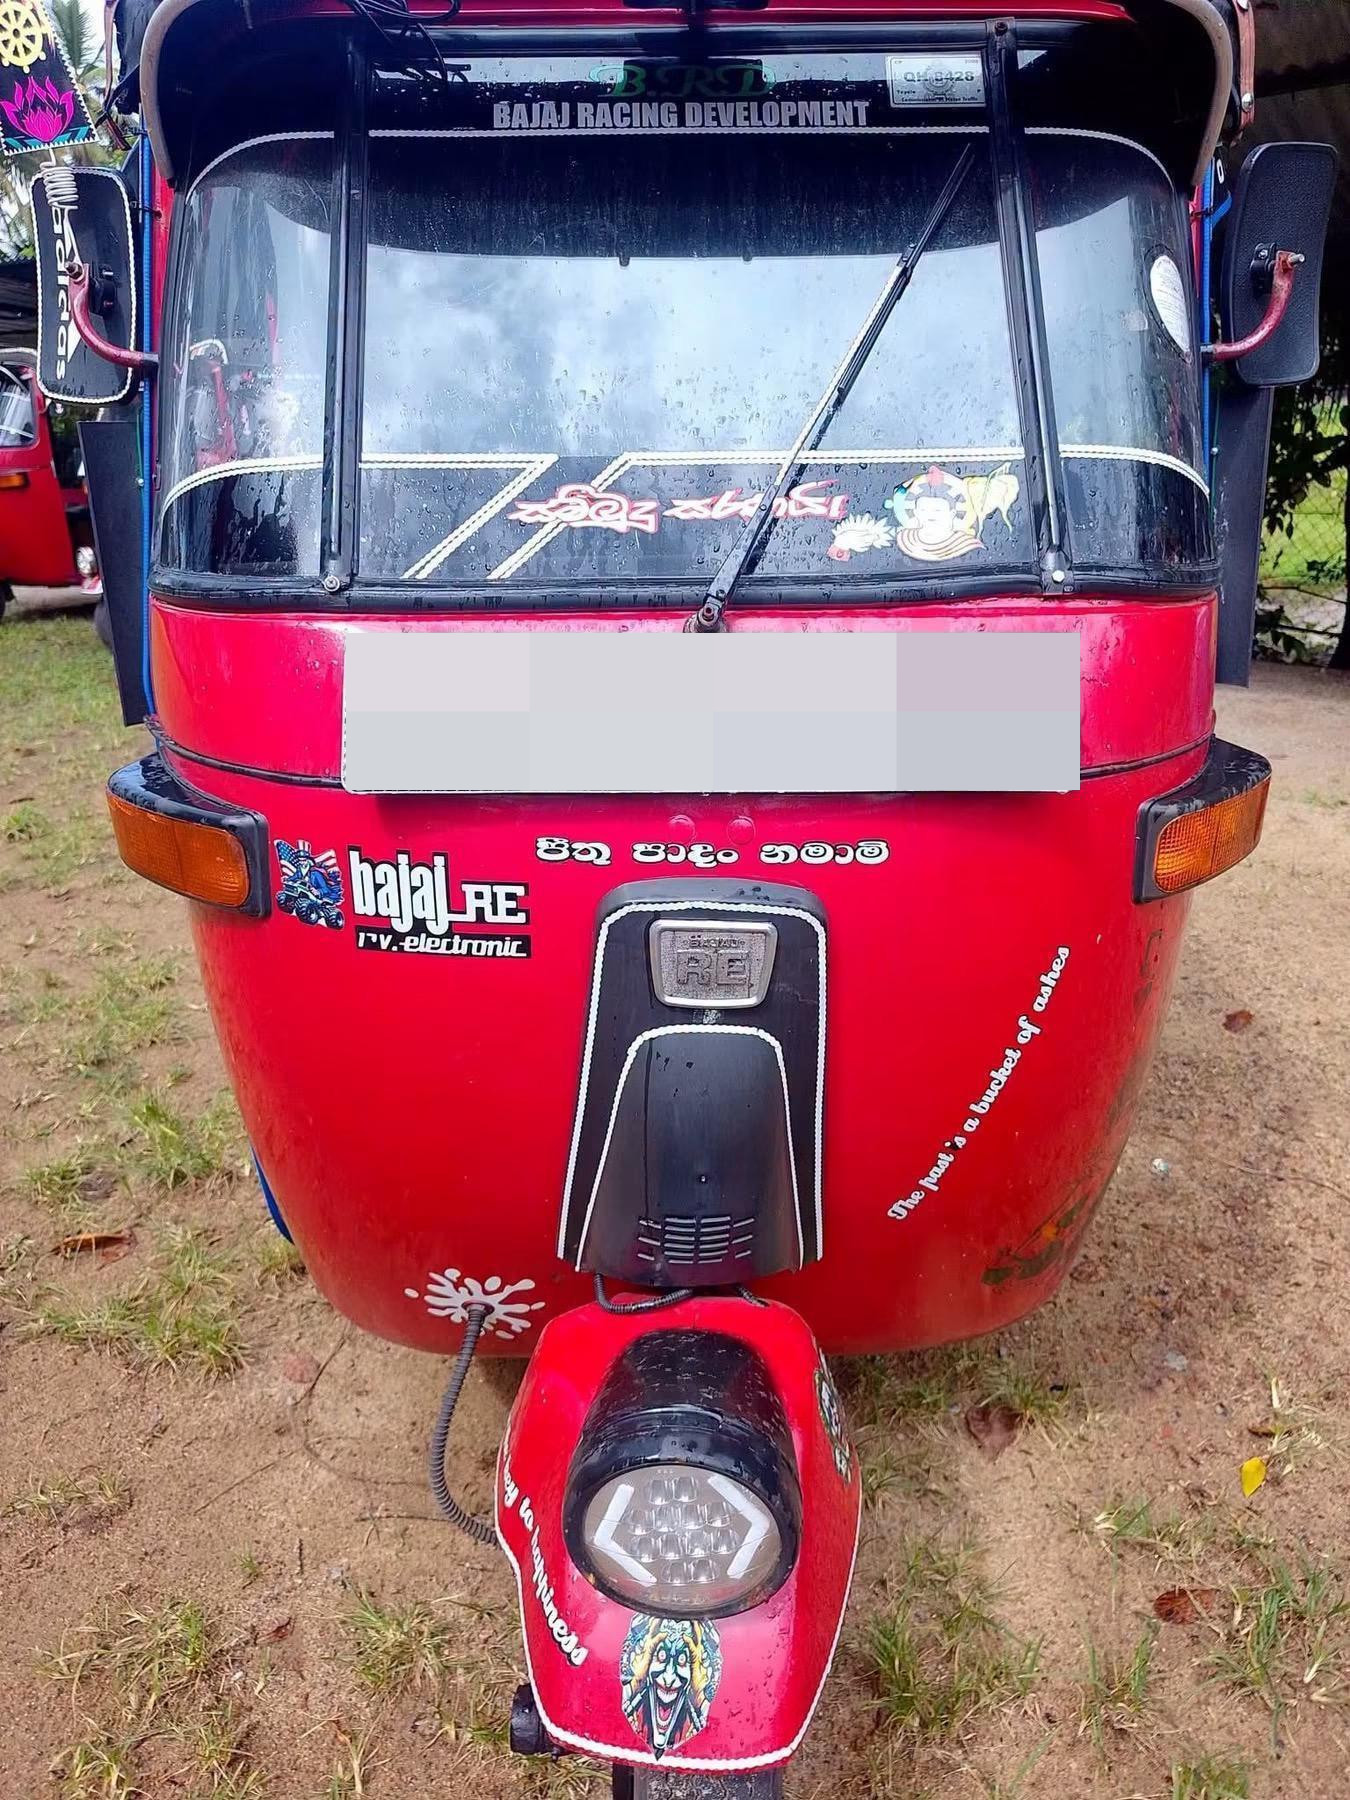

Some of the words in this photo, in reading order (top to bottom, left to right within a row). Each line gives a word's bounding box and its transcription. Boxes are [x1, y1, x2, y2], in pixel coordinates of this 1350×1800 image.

[493, 102, 570, 129] BAJAJ
[577, 102, 678, 128] RACING
[685, 101, 870, 127] DEVELOPMENT
[349, 850, 450, 936] bajaj
[460, 883, 526, 924] RE
[676, 949, 751, 986] RE
[1032, 946, 1070, 1012] ashes
[1016, 1015, 1042, 1045] of
[969, 1047, 1022, 1114] bucket
[963, 1117, 980, 1133] a
[918, 1152, 955, 1192] past
[887, 1189, 926, 1220] The
[518, 1496, 534, 1532] to
[530, 1524, 589, 1667] happiness
